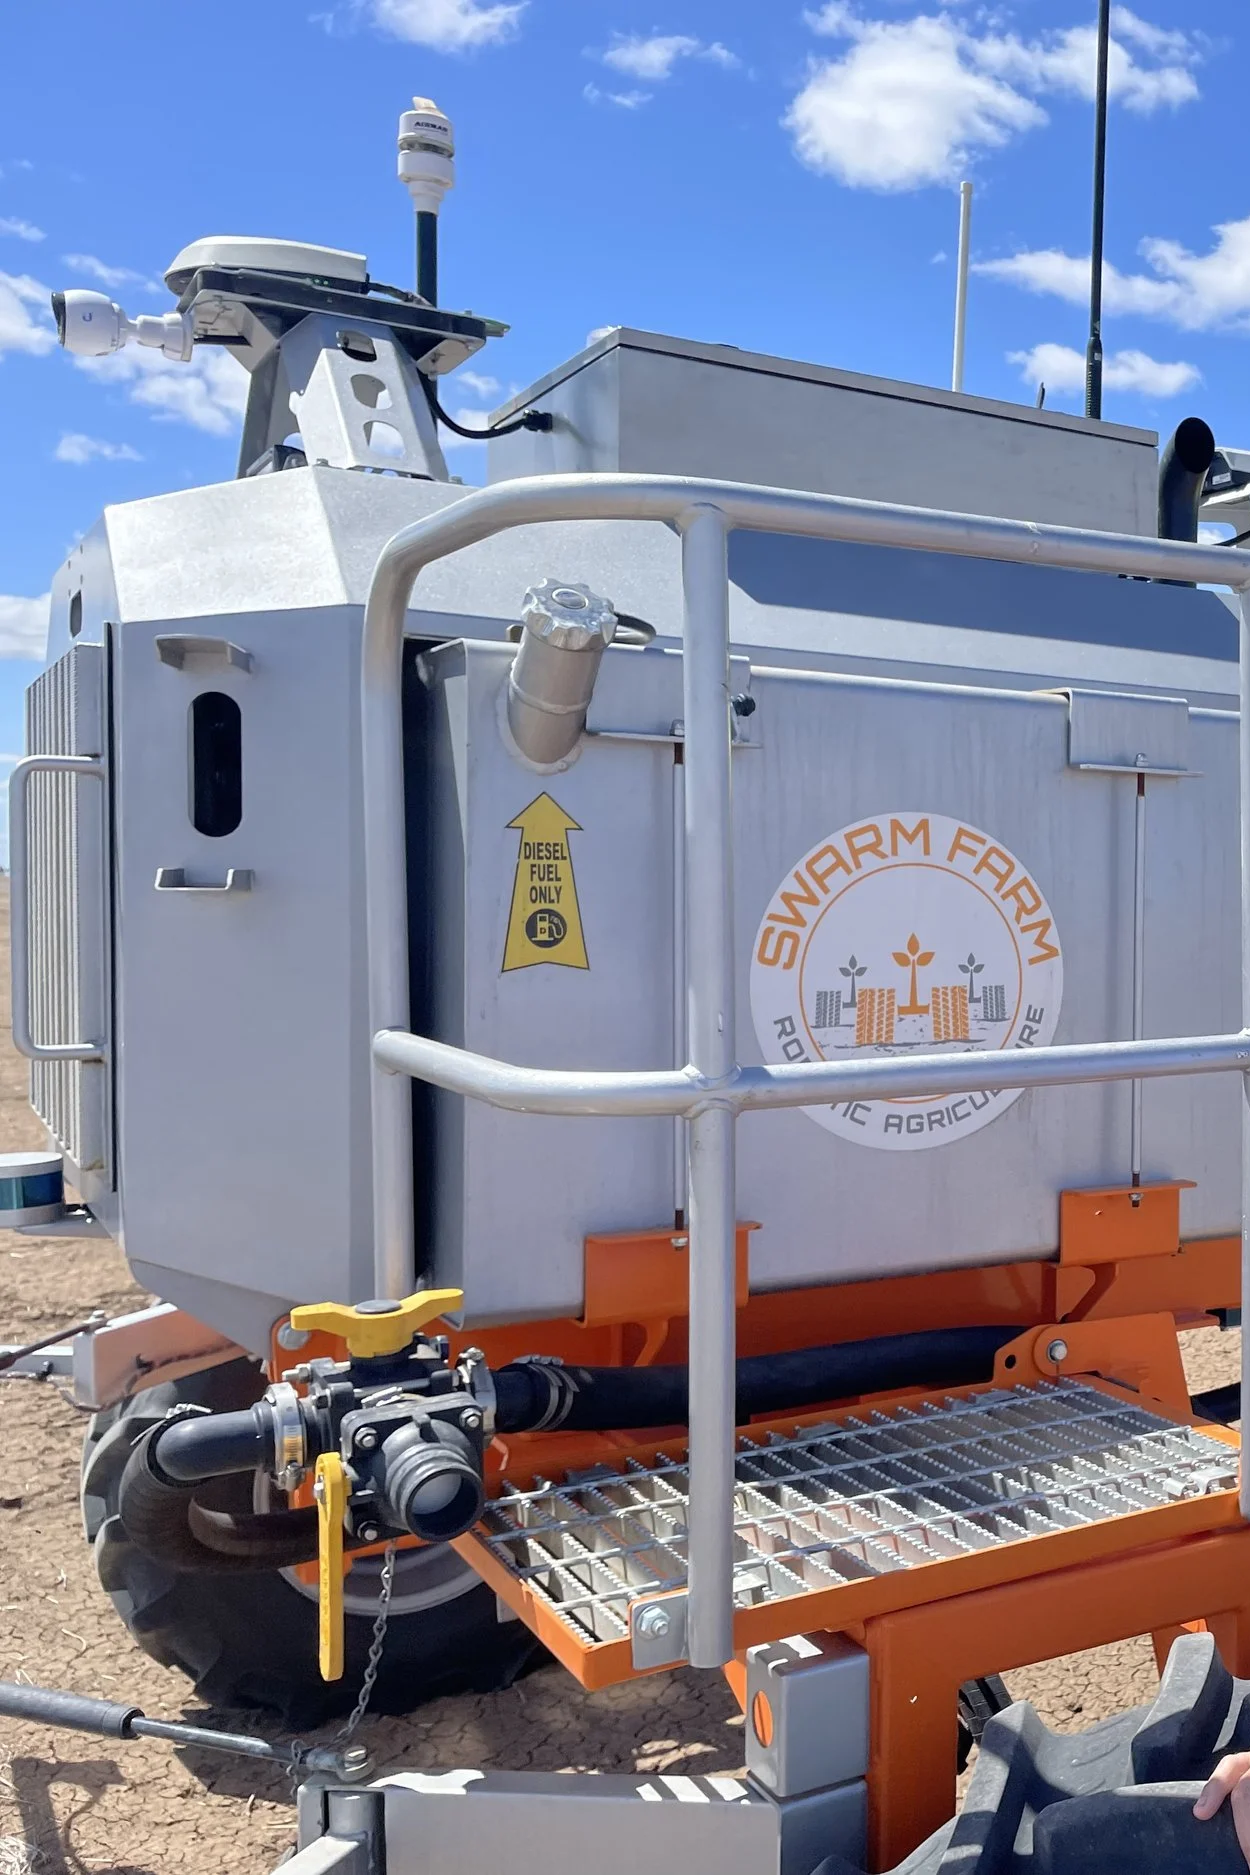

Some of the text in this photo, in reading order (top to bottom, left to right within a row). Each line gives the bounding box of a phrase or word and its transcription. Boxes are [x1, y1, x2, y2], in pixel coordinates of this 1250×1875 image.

[523, 841, 568, 861] DIESEL
[530, 863, 562, 882] FUEL
[529, 885, 563, 904] ONLY
[757, 818, 1060, 971] SWARM FARM
[773, 1004, 1044, 1134] ROIC AGRICURE
